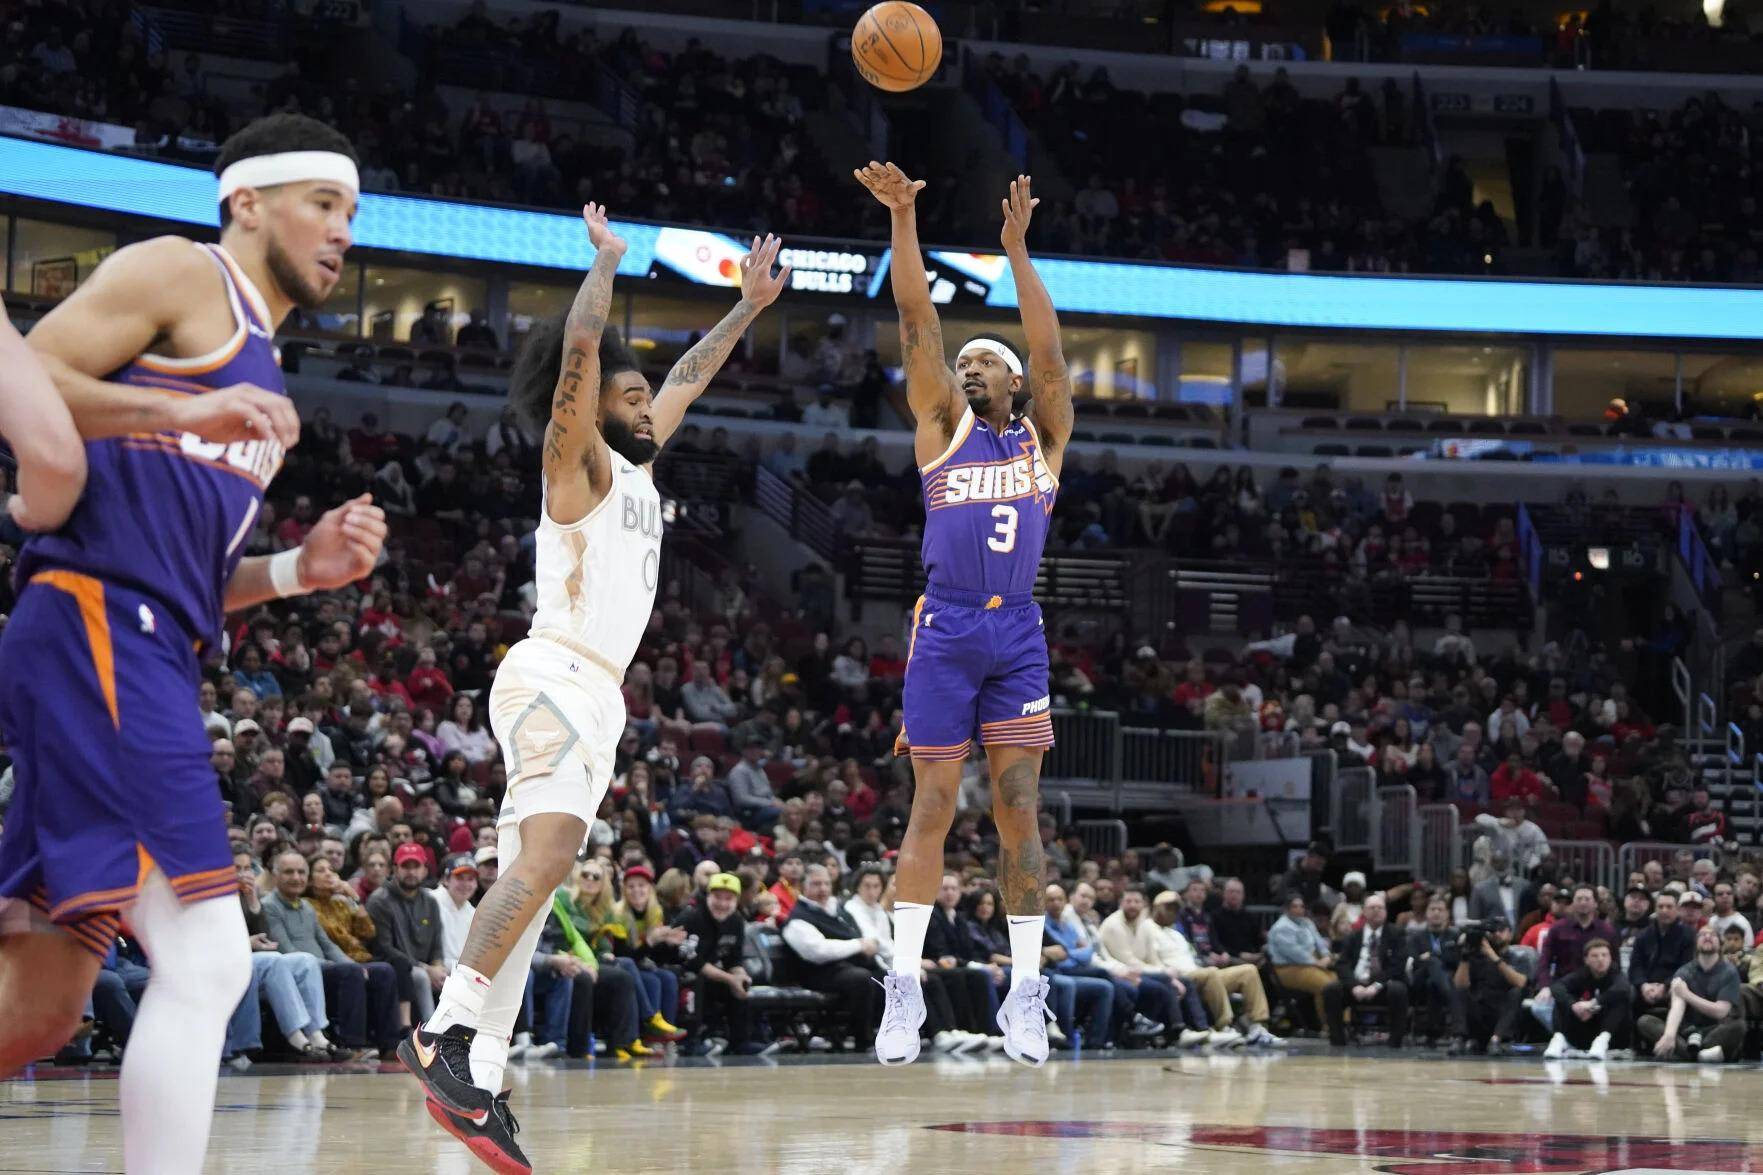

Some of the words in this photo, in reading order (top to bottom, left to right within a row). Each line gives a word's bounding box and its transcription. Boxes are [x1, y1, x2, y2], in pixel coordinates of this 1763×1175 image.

[779, 248, 867, 274] CHICAGO
[791, 269, 852, 293] BULLS
[987, 504, 1018, 554] 3
